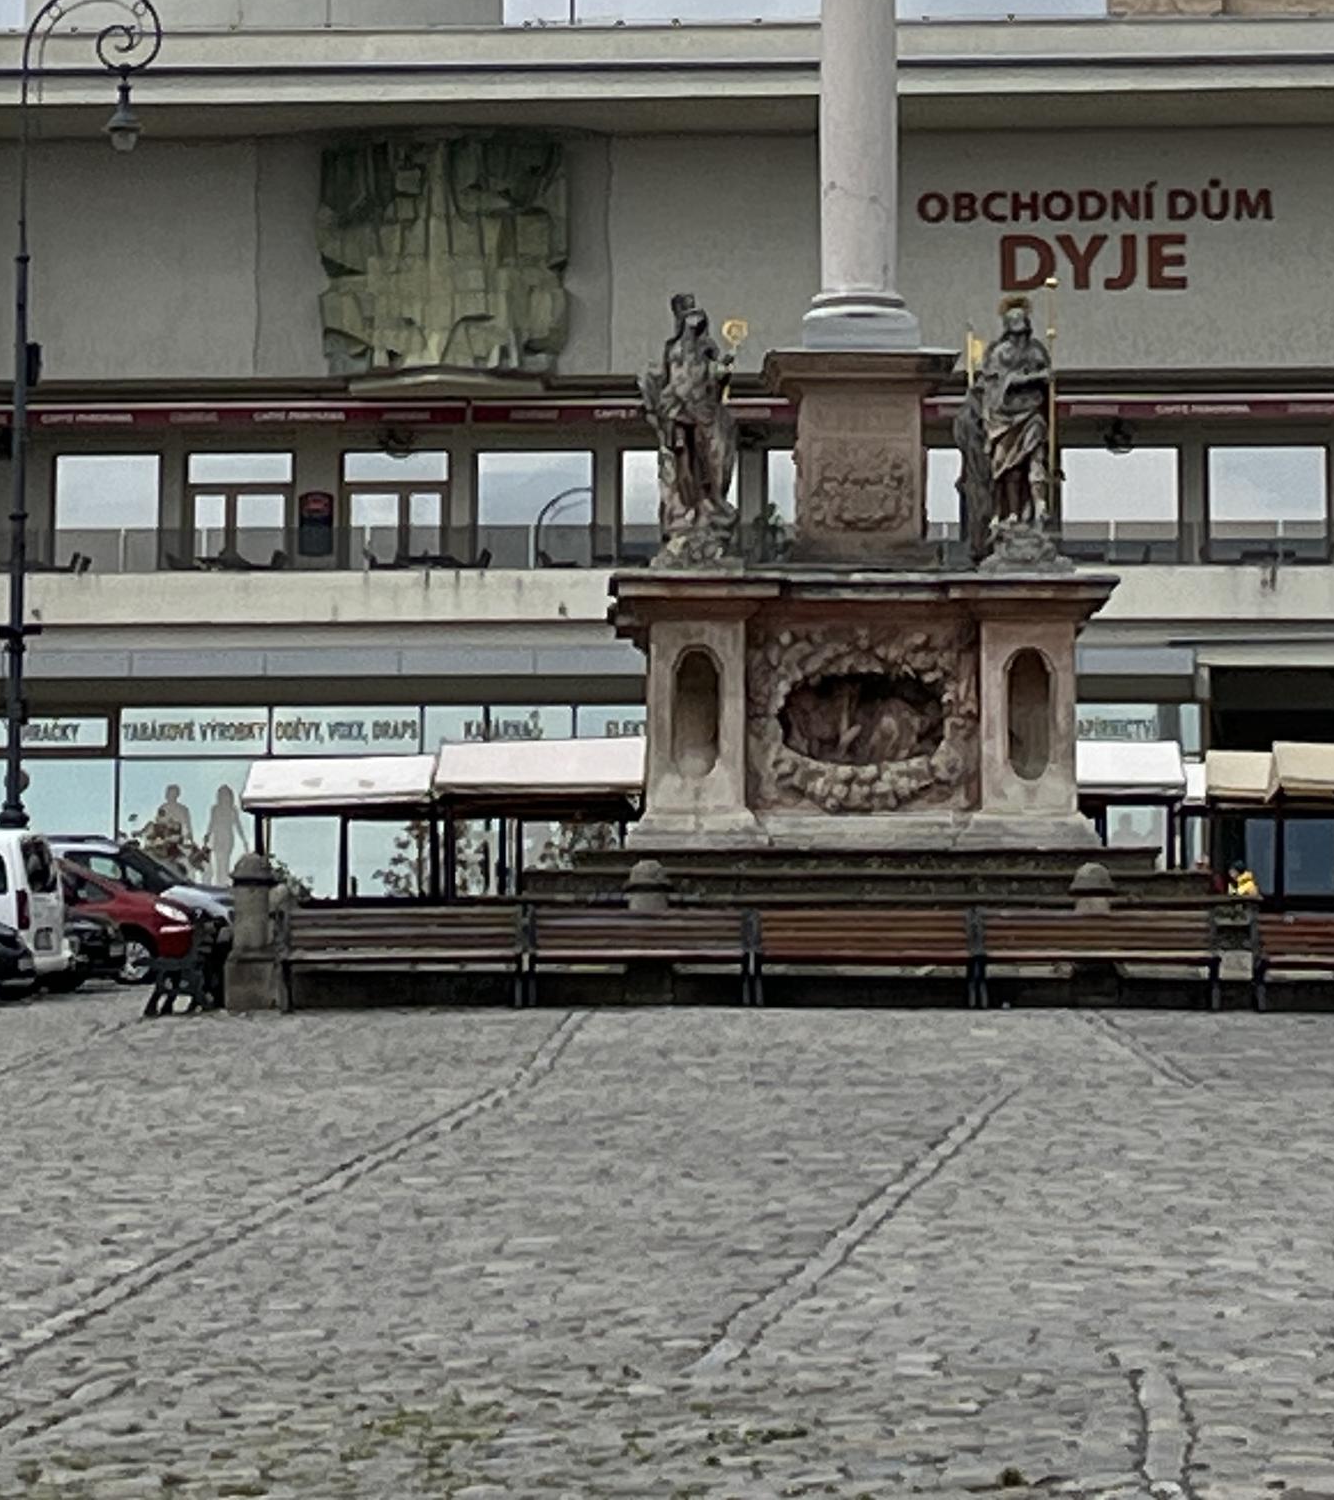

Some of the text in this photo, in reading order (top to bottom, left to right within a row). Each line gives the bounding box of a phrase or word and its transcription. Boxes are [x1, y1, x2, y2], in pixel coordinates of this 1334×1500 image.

[917, 178, 1274, 223] OBCHODNÍ DŮM
[1000, 234, 1188, 291] DYJE
